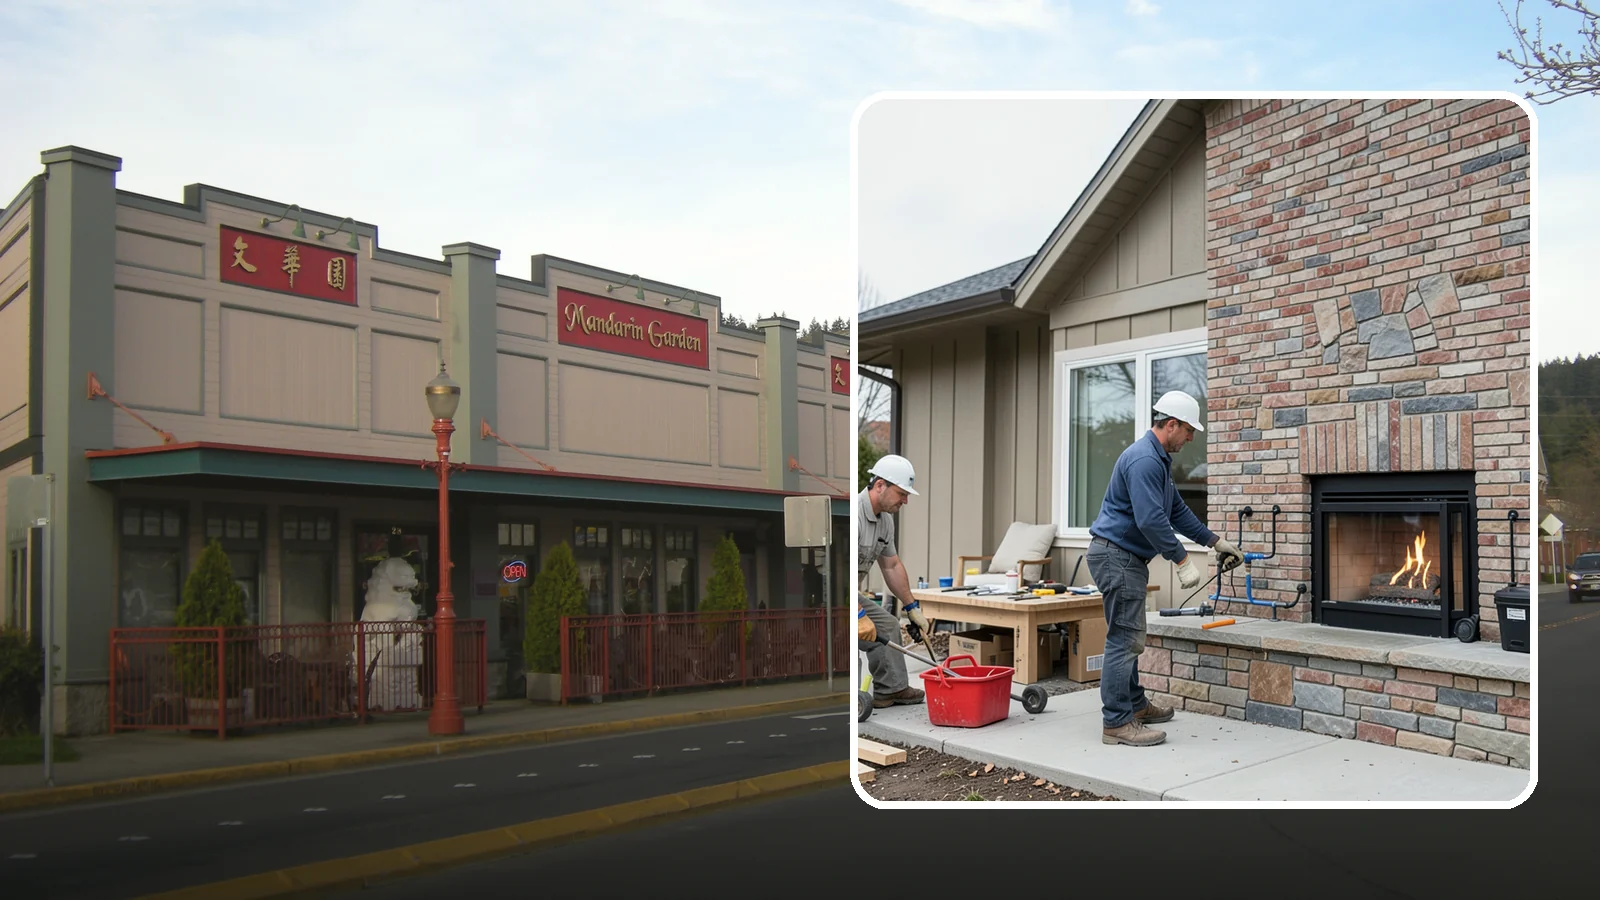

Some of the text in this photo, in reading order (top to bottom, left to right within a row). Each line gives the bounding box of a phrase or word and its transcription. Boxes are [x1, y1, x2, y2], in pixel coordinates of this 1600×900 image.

[231, 236, 346, 291] 文華園
[564, 302, 702, 353] Mandarin Garden
[503, 565, 527, 578] OPEN
